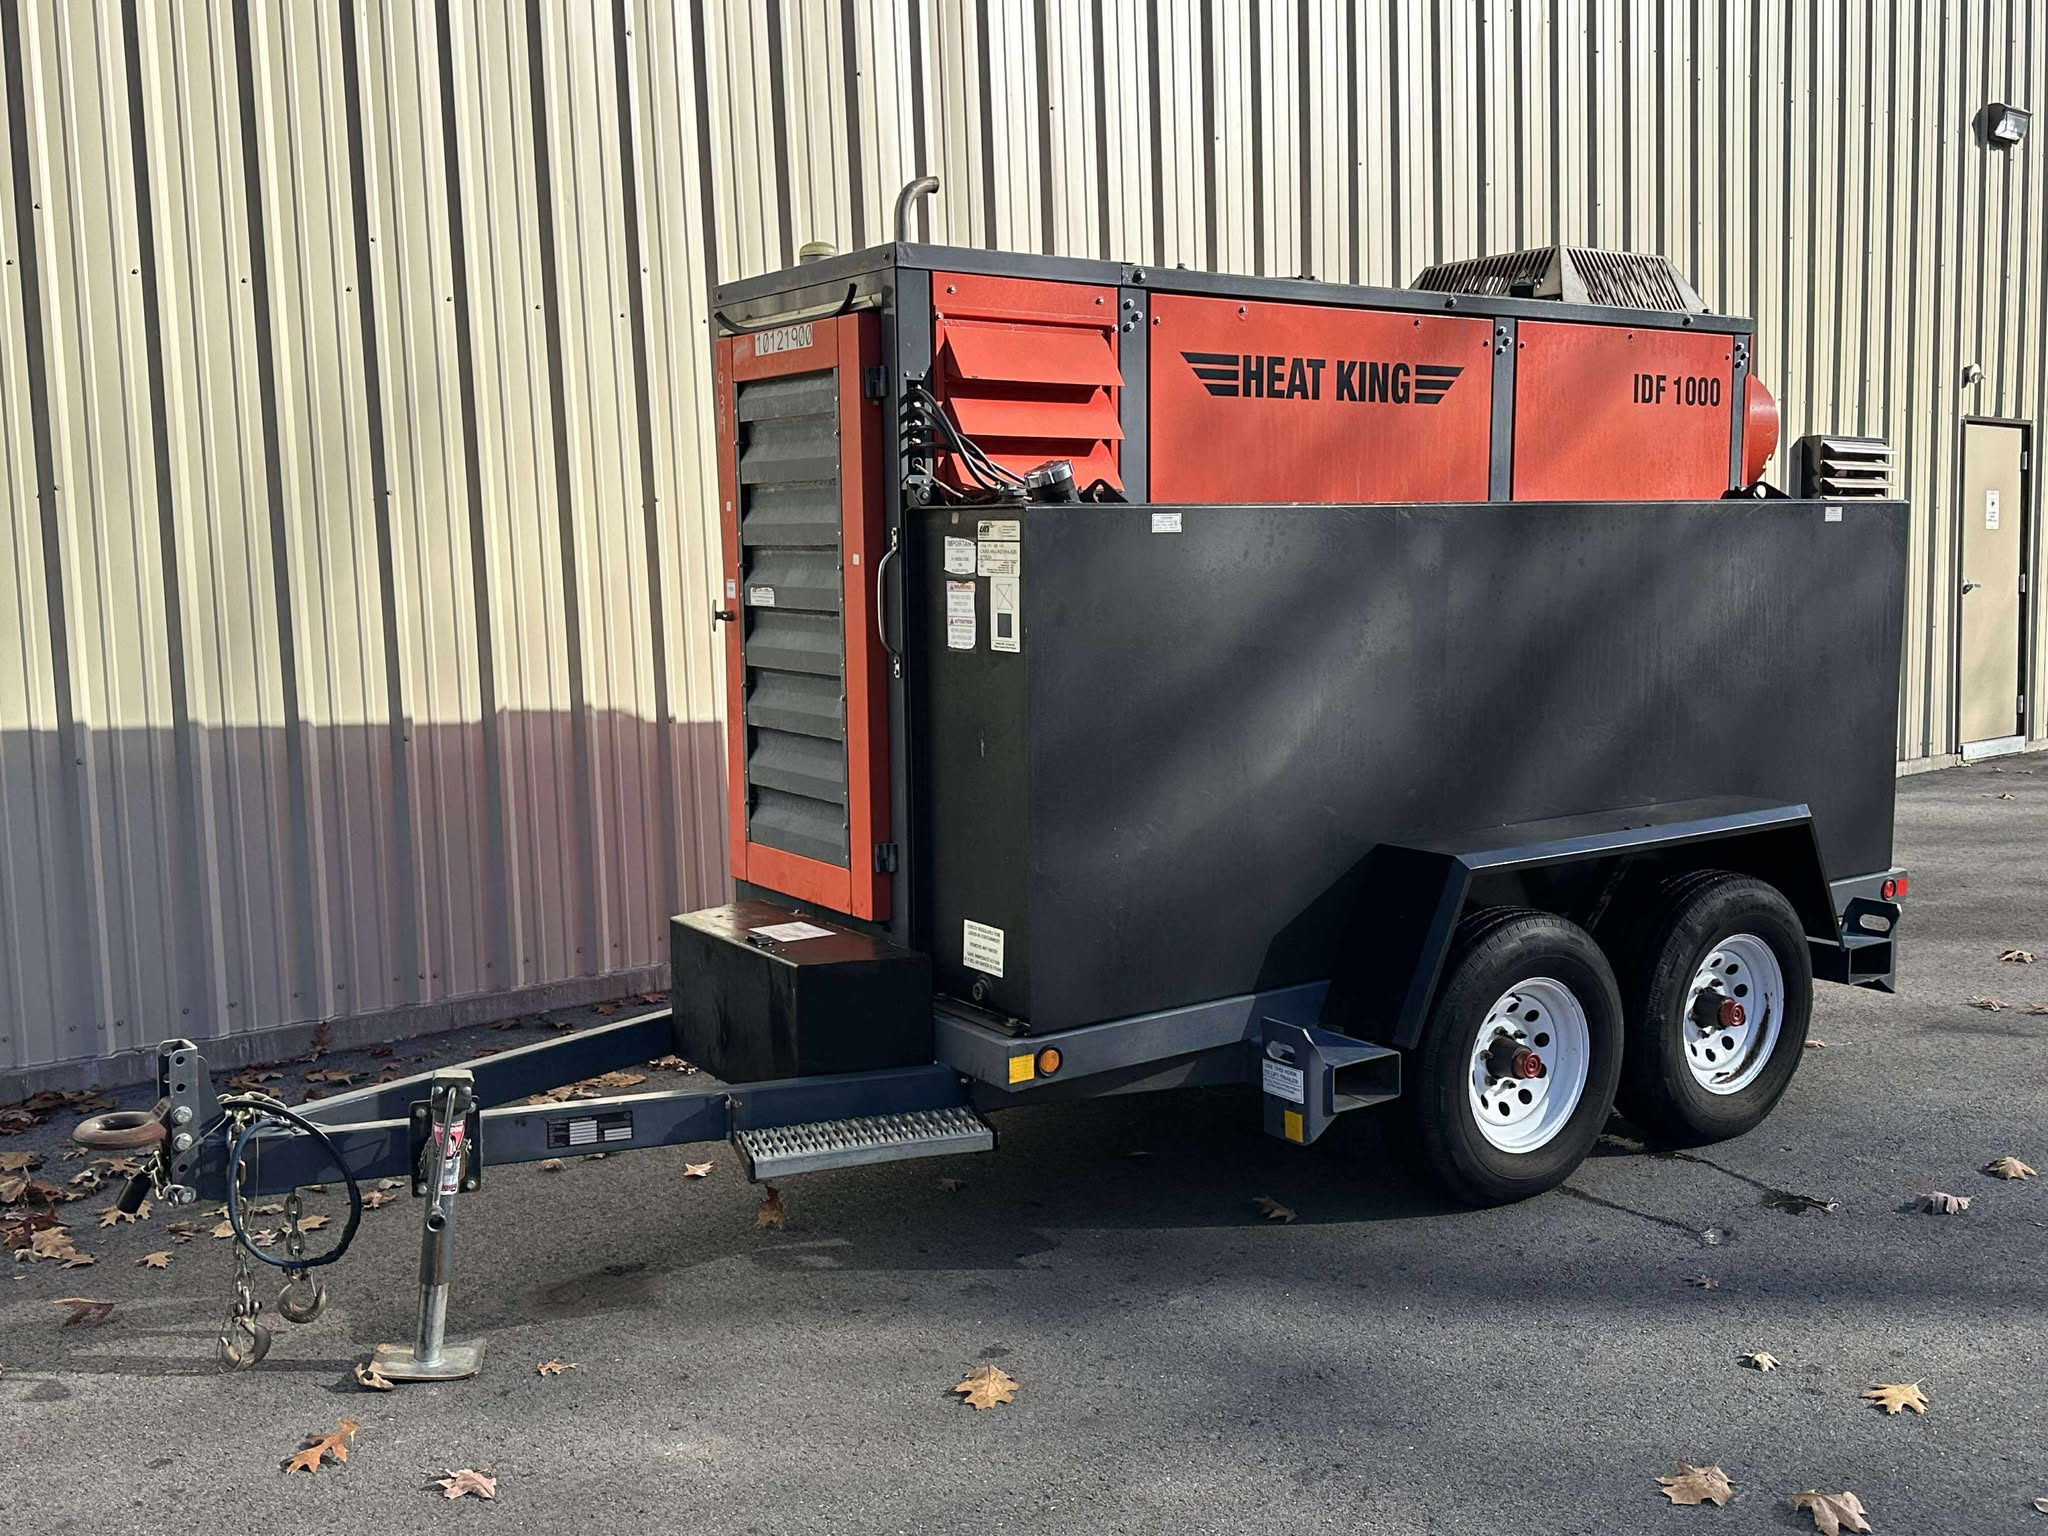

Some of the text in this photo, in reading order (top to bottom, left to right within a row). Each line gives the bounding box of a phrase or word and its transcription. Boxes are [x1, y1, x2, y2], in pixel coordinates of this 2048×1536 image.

[757, 324, 812, 354] 10121900
[1243, 355, 1410, 404] HEAT KING
[1634, 374, 1720, 406] IDF 1000
